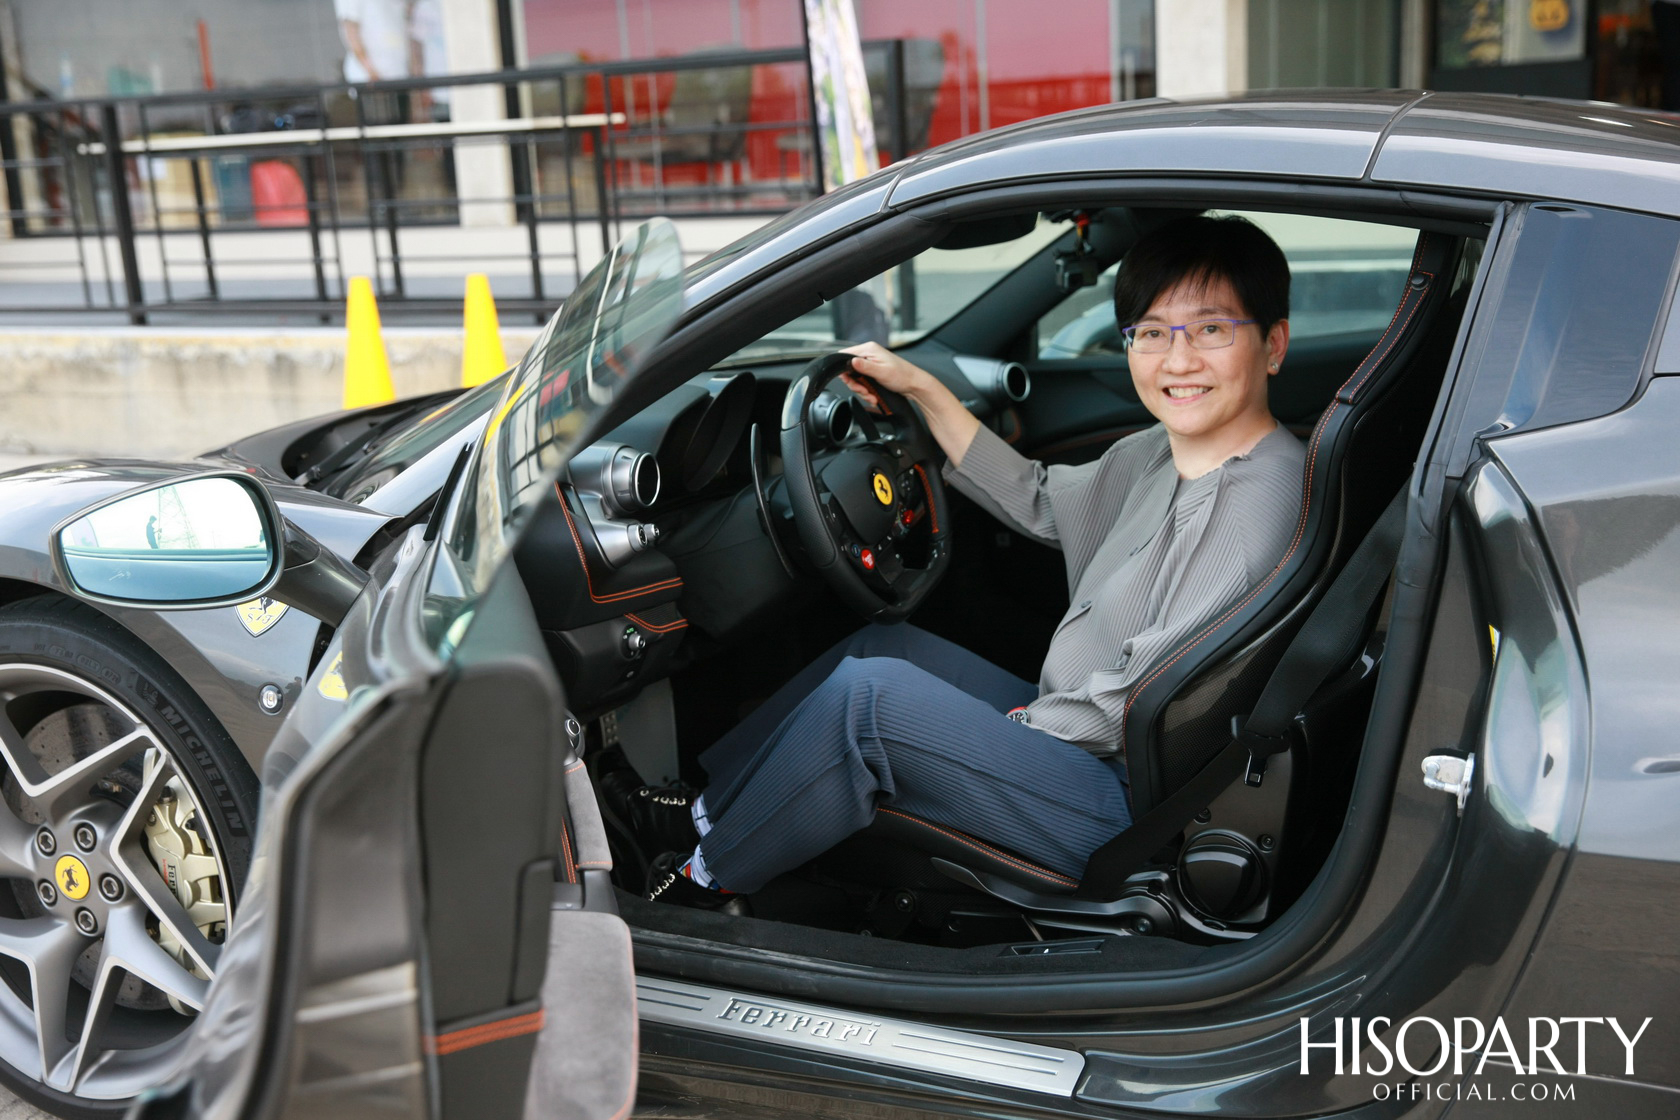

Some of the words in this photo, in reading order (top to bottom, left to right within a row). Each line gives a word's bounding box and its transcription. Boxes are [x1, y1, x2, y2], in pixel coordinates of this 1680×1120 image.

[161, 704, 244, 829] MICHELIN
[168, 864, 176, 896] Ferr
[716, 997, 881, 1046] Ferrari
